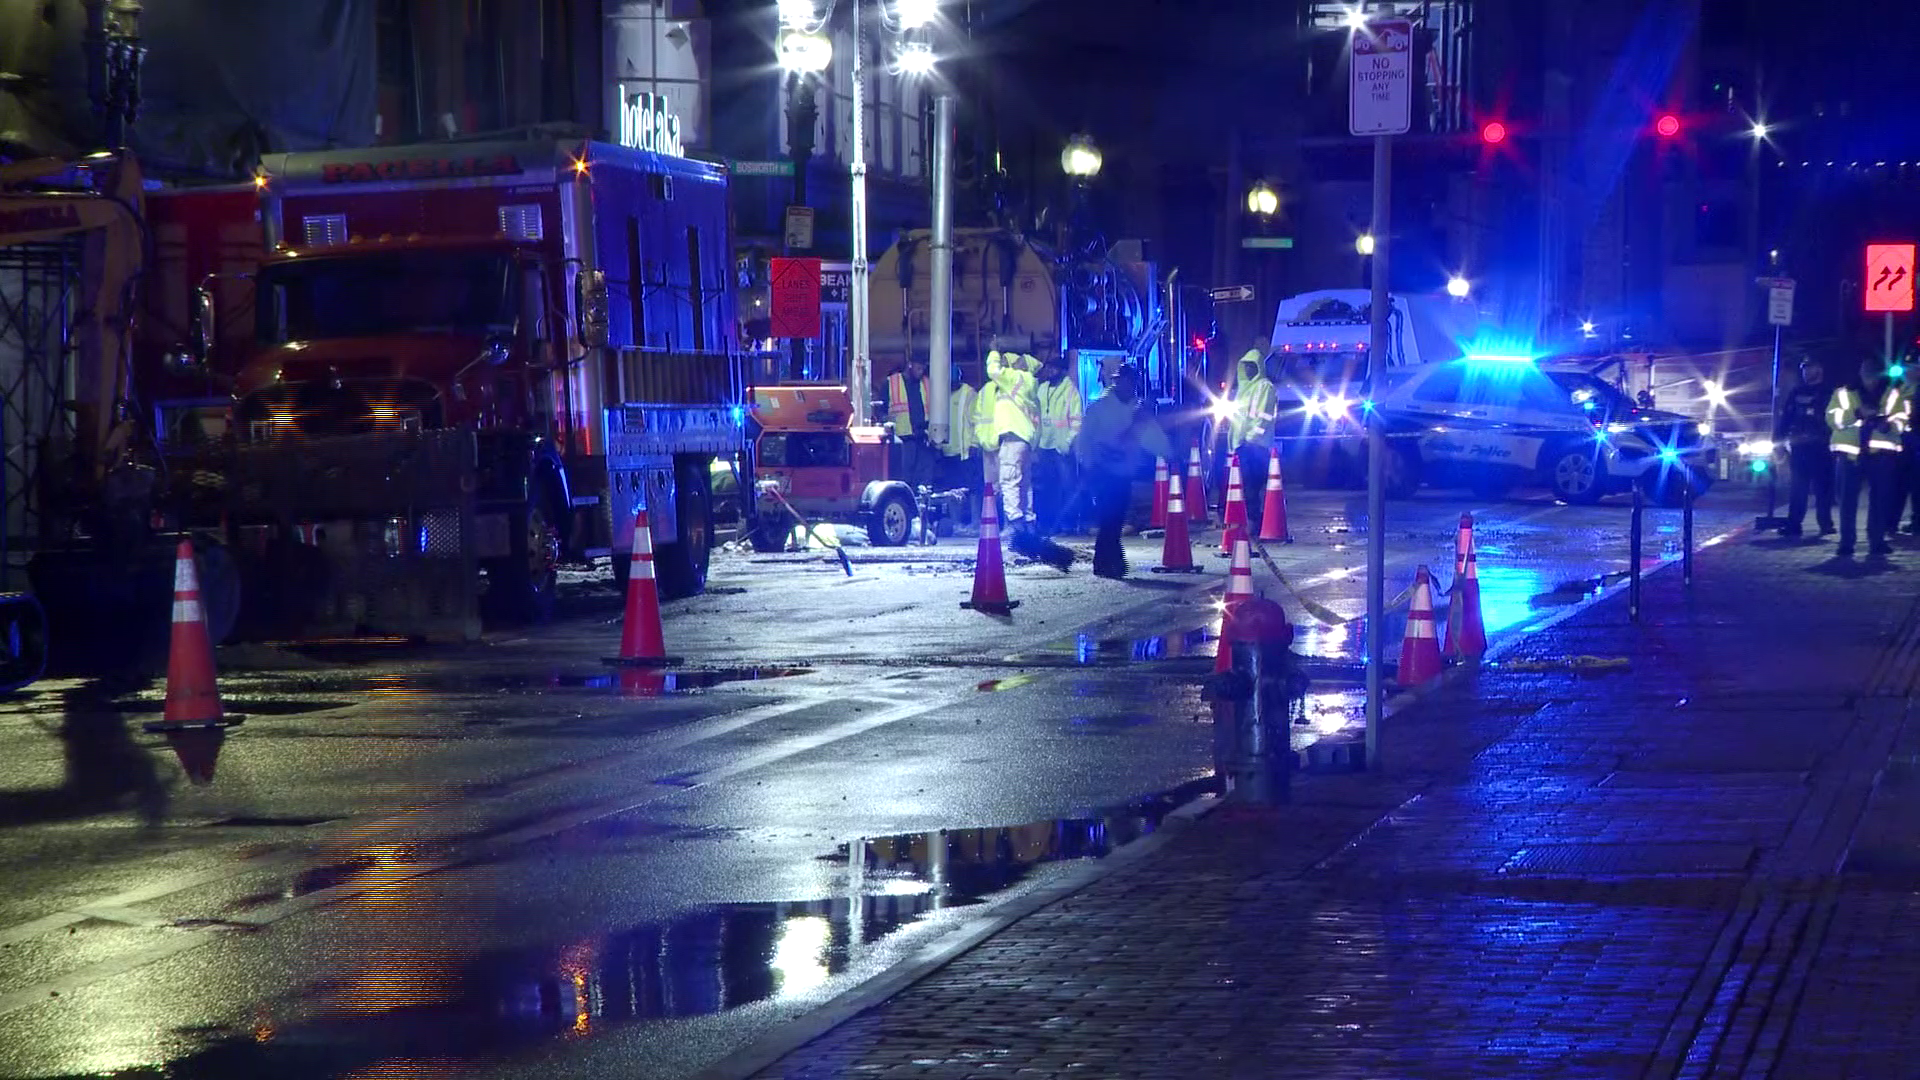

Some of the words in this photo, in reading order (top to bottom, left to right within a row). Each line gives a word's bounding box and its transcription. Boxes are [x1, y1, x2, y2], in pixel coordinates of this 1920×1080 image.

[1372, 57, 1390, 69] NO
[1358, 70, 1405, 81] STOPPING
[1372, 82, 1390, 91] ANY
[1371, 93, 1390, 102] TIME
[619, 84, 655, 152] hotel
[321, 157, 523, 183] PACELLA
[782, 280, 810, 289] LANES
[1468, 445, 1512, 457] Police
